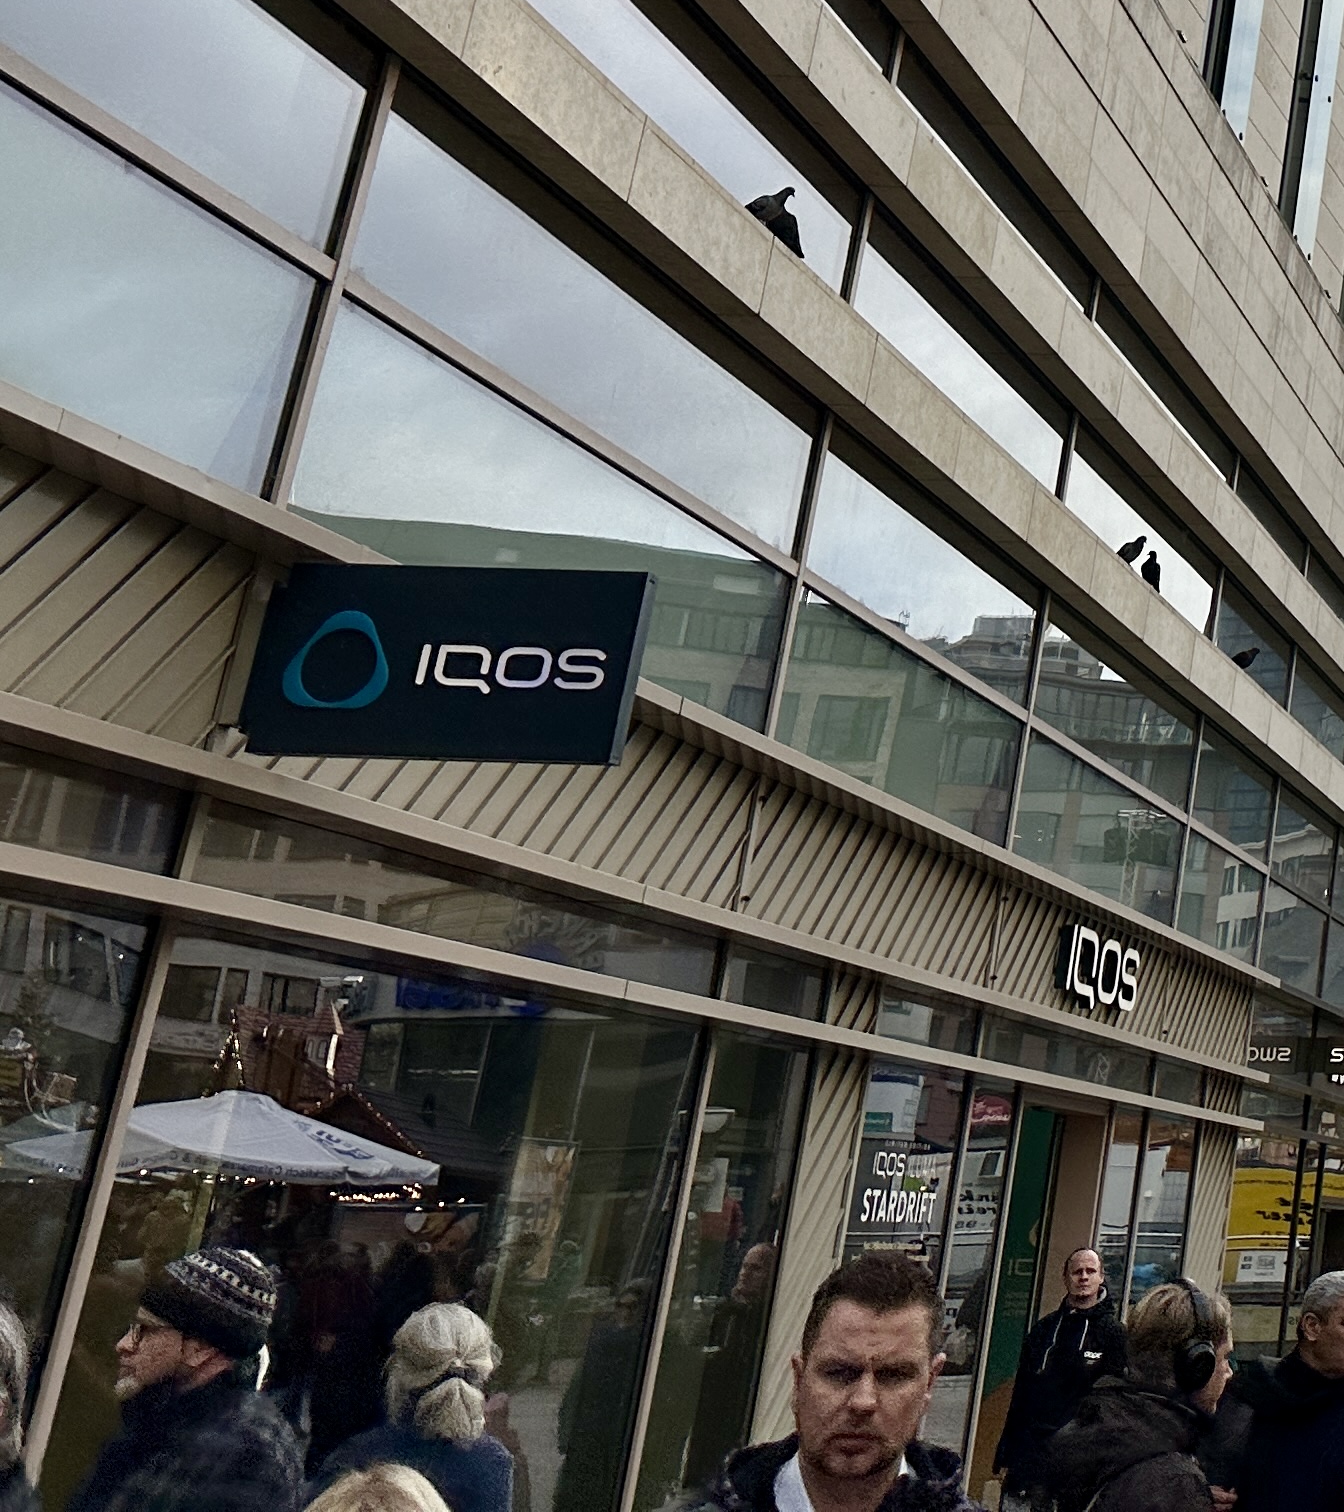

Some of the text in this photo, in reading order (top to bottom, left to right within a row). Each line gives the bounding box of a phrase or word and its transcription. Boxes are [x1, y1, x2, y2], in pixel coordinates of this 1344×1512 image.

[415, 643, 607, 695] IQOS
[1066, 924, 1140, 1012] IQOS
[873, 1151, 906, 1180] IQOS
[860, 1188, 937, 1224] STARDRIFT
